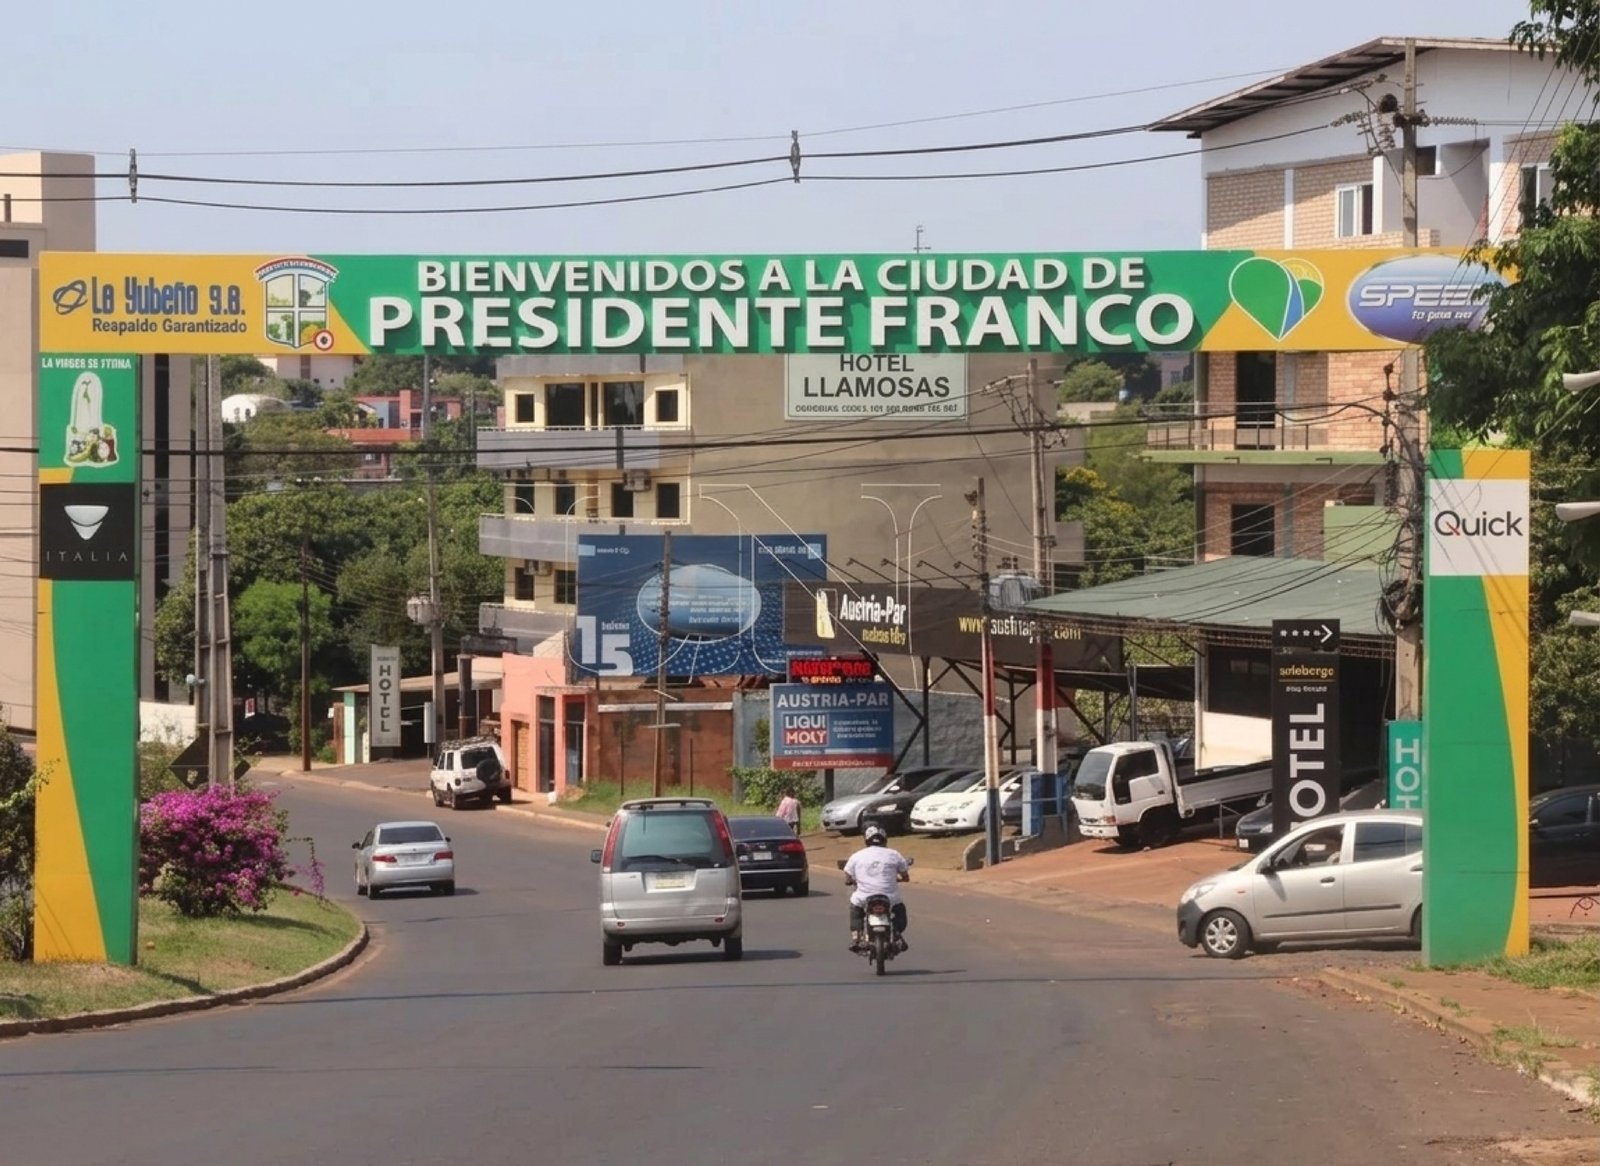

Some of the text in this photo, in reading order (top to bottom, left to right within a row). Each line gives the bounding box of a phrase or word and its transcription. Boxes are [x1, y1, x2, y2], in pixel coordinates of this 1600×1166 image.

[418, 256, 1146, 293] BIENVENIDOS A LA CIUDAD DE
[162, 317, 247, 333] Garantizado
[369, 293, 1195, 349] PRESIDENTE FRANCO
[839, 354, 915, 372] HOTEL
[804, 376, 950, 398] LLAMOSAS
[1434, 510, 1523, 537] Quick
[46, 551, 128, 562] ITALIA
[576, 615, 634, 677] 15
[776, 692, 889, 708] AUSTRIA-PAR
[785, 730, 827, 745] MOLY
[1289, 703, 1325, 832] OTEL
